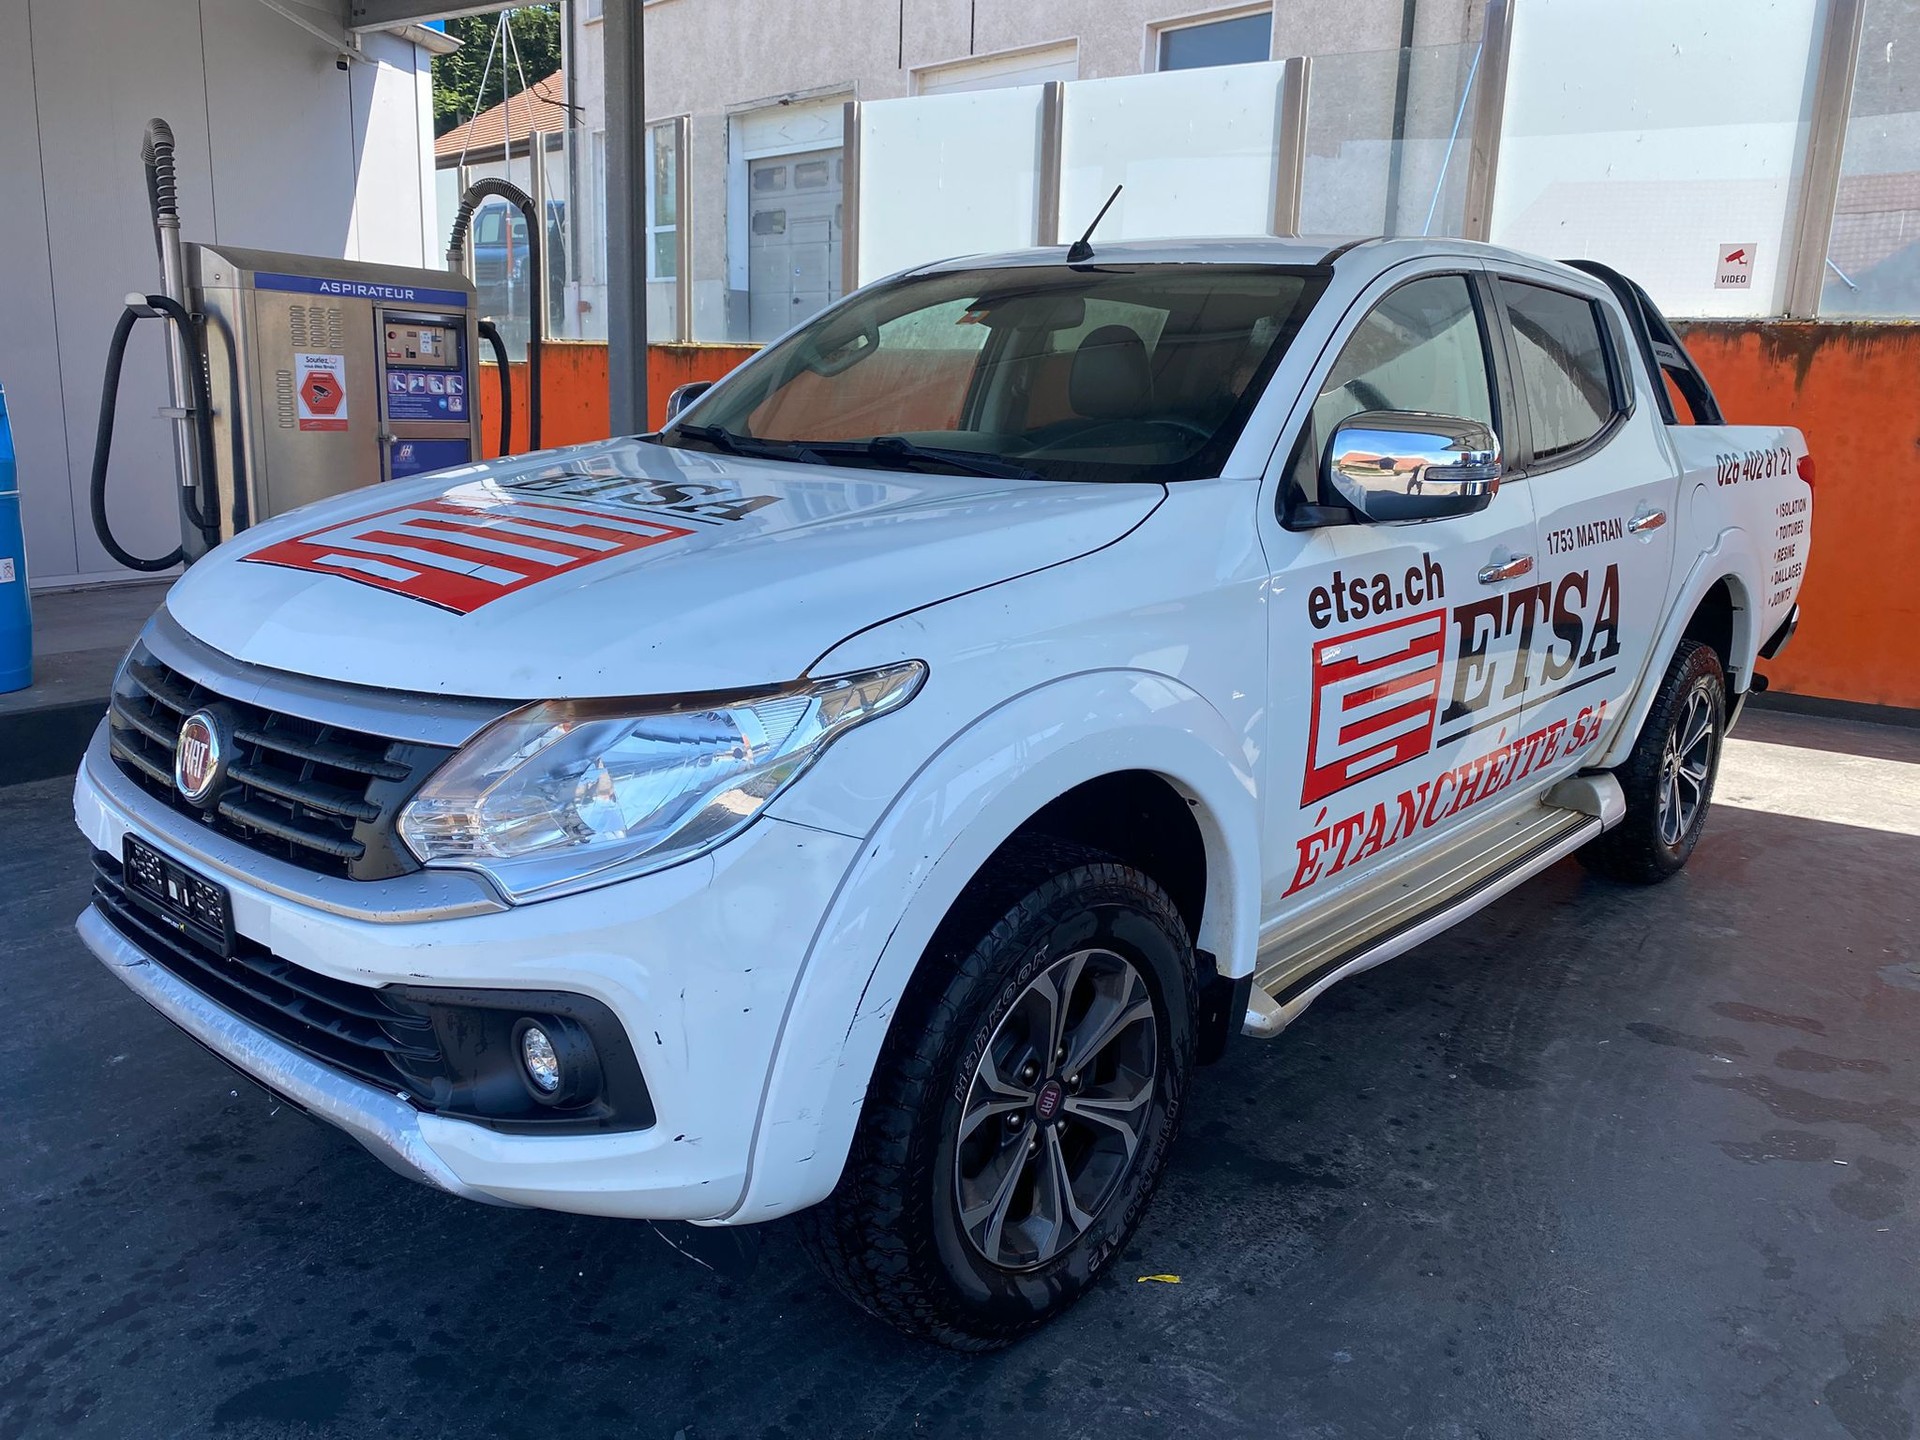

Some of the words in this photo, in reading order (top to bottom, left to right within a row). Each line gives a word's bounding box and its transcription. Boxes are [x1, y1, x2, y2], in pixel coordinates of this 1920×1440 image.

[320, 281, 414, 300] ASPIRATEUR
[1721, 275, 1747, 283] VIDEO
[1716, 454, 1740, 487] 026
[1743, 450, 1764, 481] 402
[1765, 448, 1778, 478] 81
[1780, 447, 1791, 475] 21
[502, 472, 785, 521] ETSA
[1780, 498, 1807, 517] ISOLATION
[1547, 528, 1574, 555] 1753
[1576, 517, 1623, 548] MATRAN
[1779, 520, 1804, 540] TOITURES
[1776, 544, 1796, 563] RESINE
[1774, 562, 1802, 585] DALLAGES
[1308, 552, 1445, 629] etsa.ch
[1771, 587, 1792, 607] JOINTS
[1440, 563, 1621, 726] ETSA
[1562, 700, 1607, 757] SA
[180, 736, 209, 779] FIAT
[1040, 1090, 1057, 1116] FIAT
